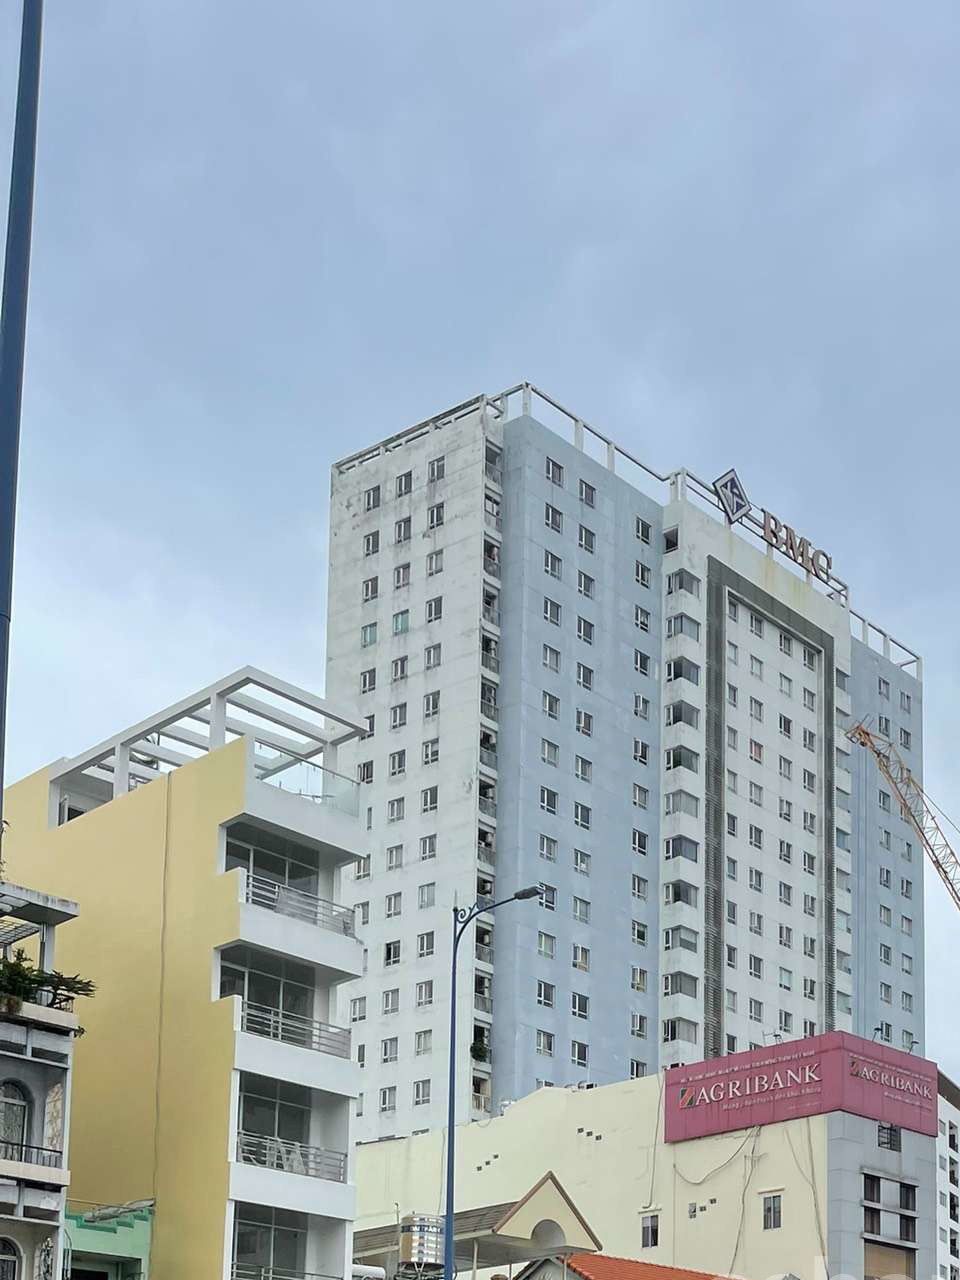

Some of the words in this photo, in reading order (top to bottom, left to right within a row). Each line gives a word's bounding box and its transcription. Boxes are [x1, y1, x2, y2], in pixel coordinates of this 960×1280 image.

[761, 508, 832, 582] BMC
[695, 1062, 822, 1106] AGRIBANK
[861, 1065, 932, 1099] AGRIBANK
